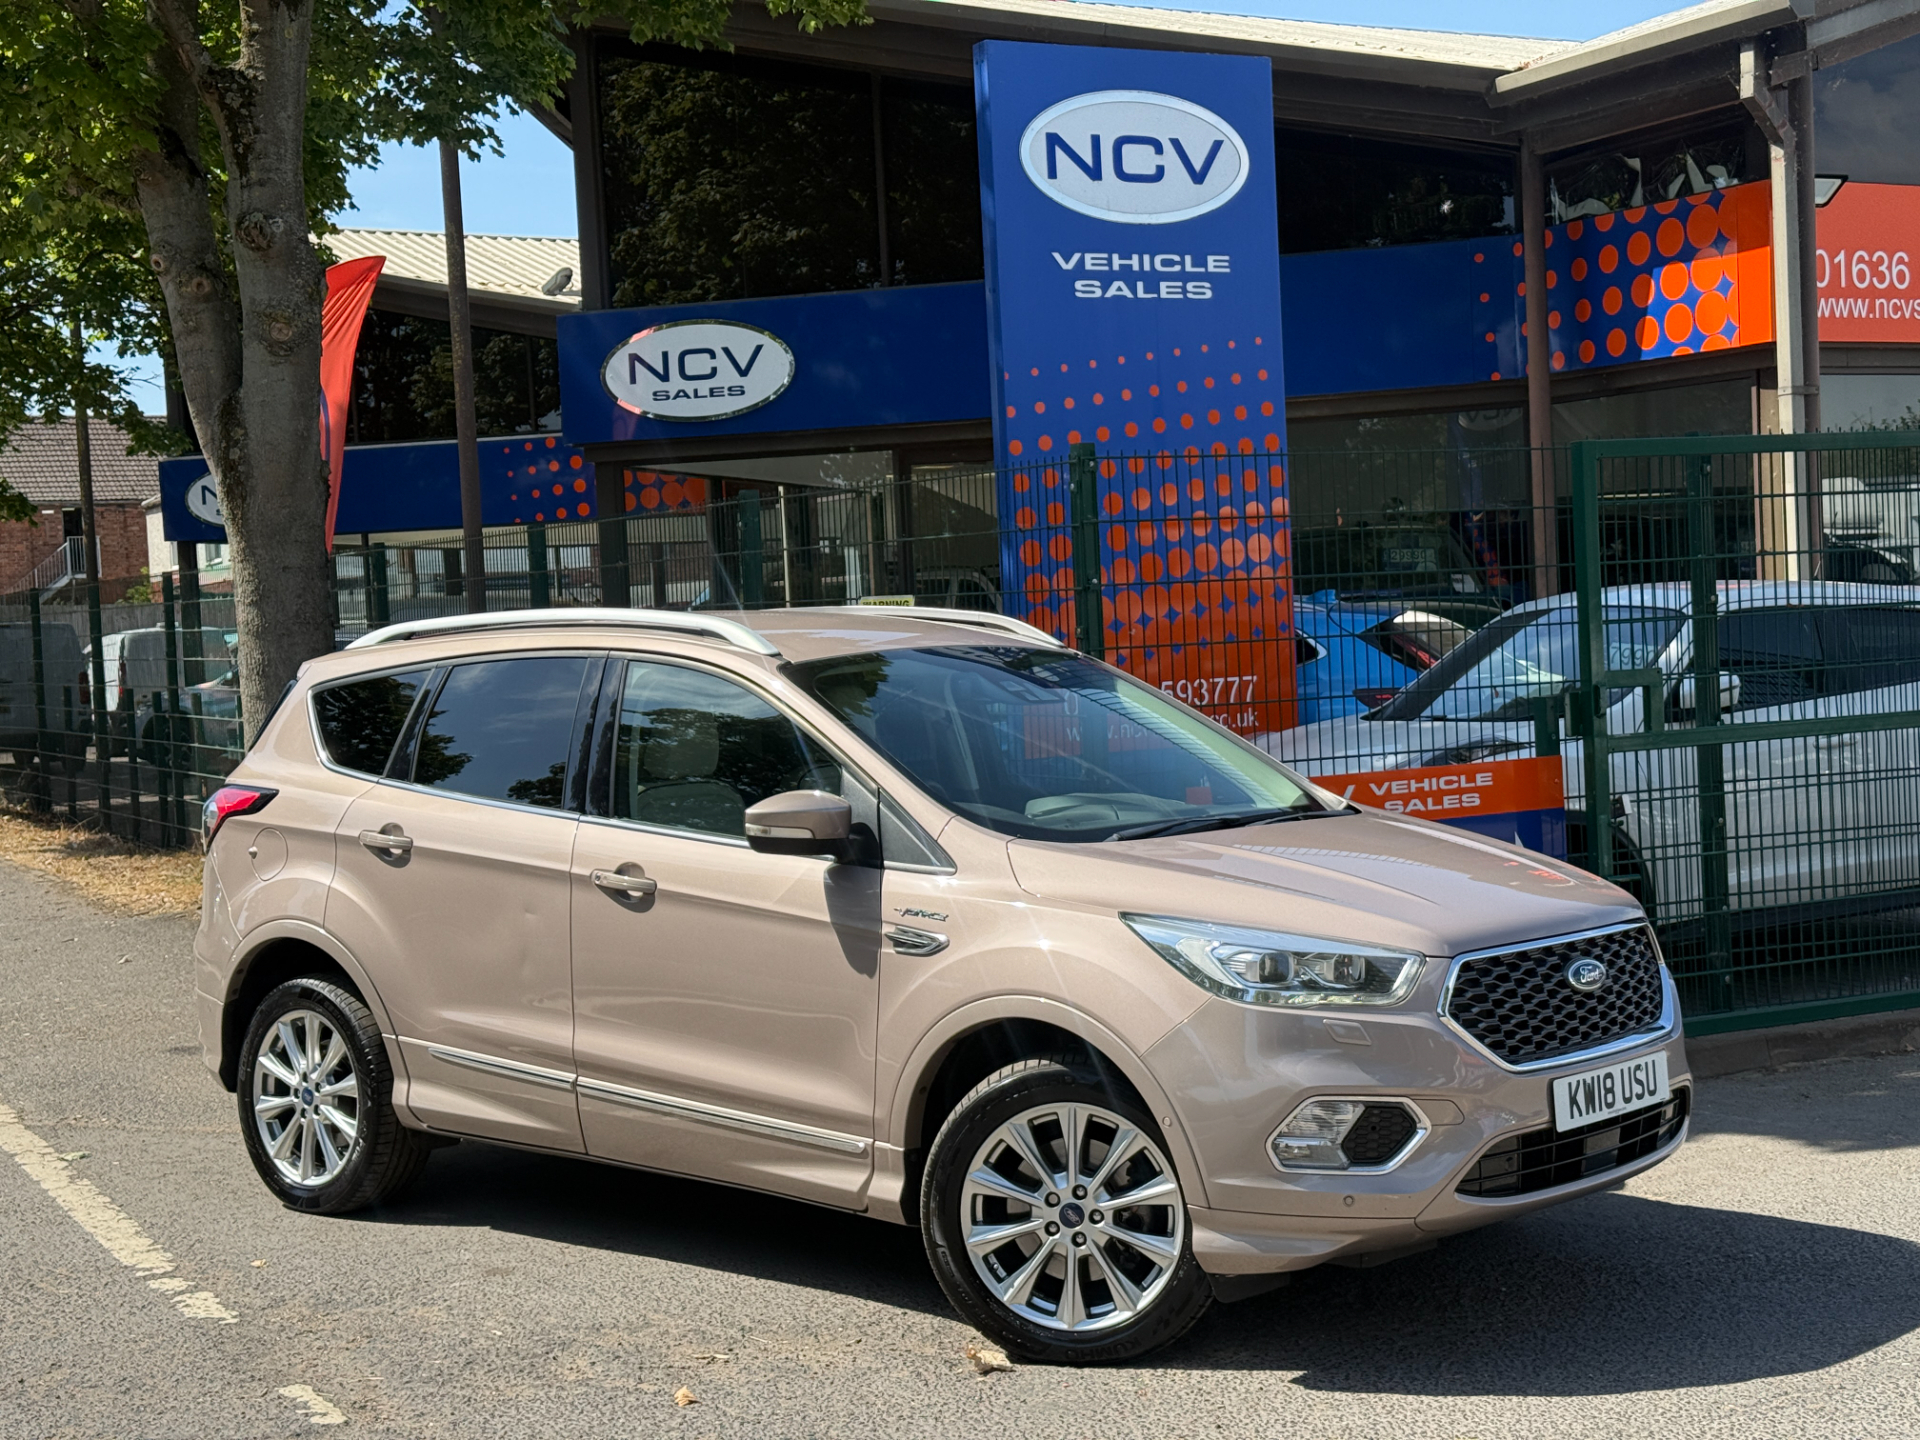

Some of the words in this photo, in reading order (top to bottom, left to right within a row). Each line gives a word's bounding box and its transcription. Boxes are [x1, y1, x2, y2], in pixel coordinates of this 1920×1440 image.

[1045, 131, 1225, 186] NCV
[1051, 251, 1232, 273] VEHICLE
[1816, 248, 1911, 291] 01636
[1074, 279, 1213, 300] SALES
[627, 343, 765, 386] NCV
[652, 384, 746, 402] SALES
[1161, 675, 1258, 706] 593777
[1369, 772, 1493, 796] VEHICLE
[1384, 793, 1481, 814] SALES
[1568, 1072, 1616, 1119] KW18
[1620, 1059, 1657, 1104] USU
